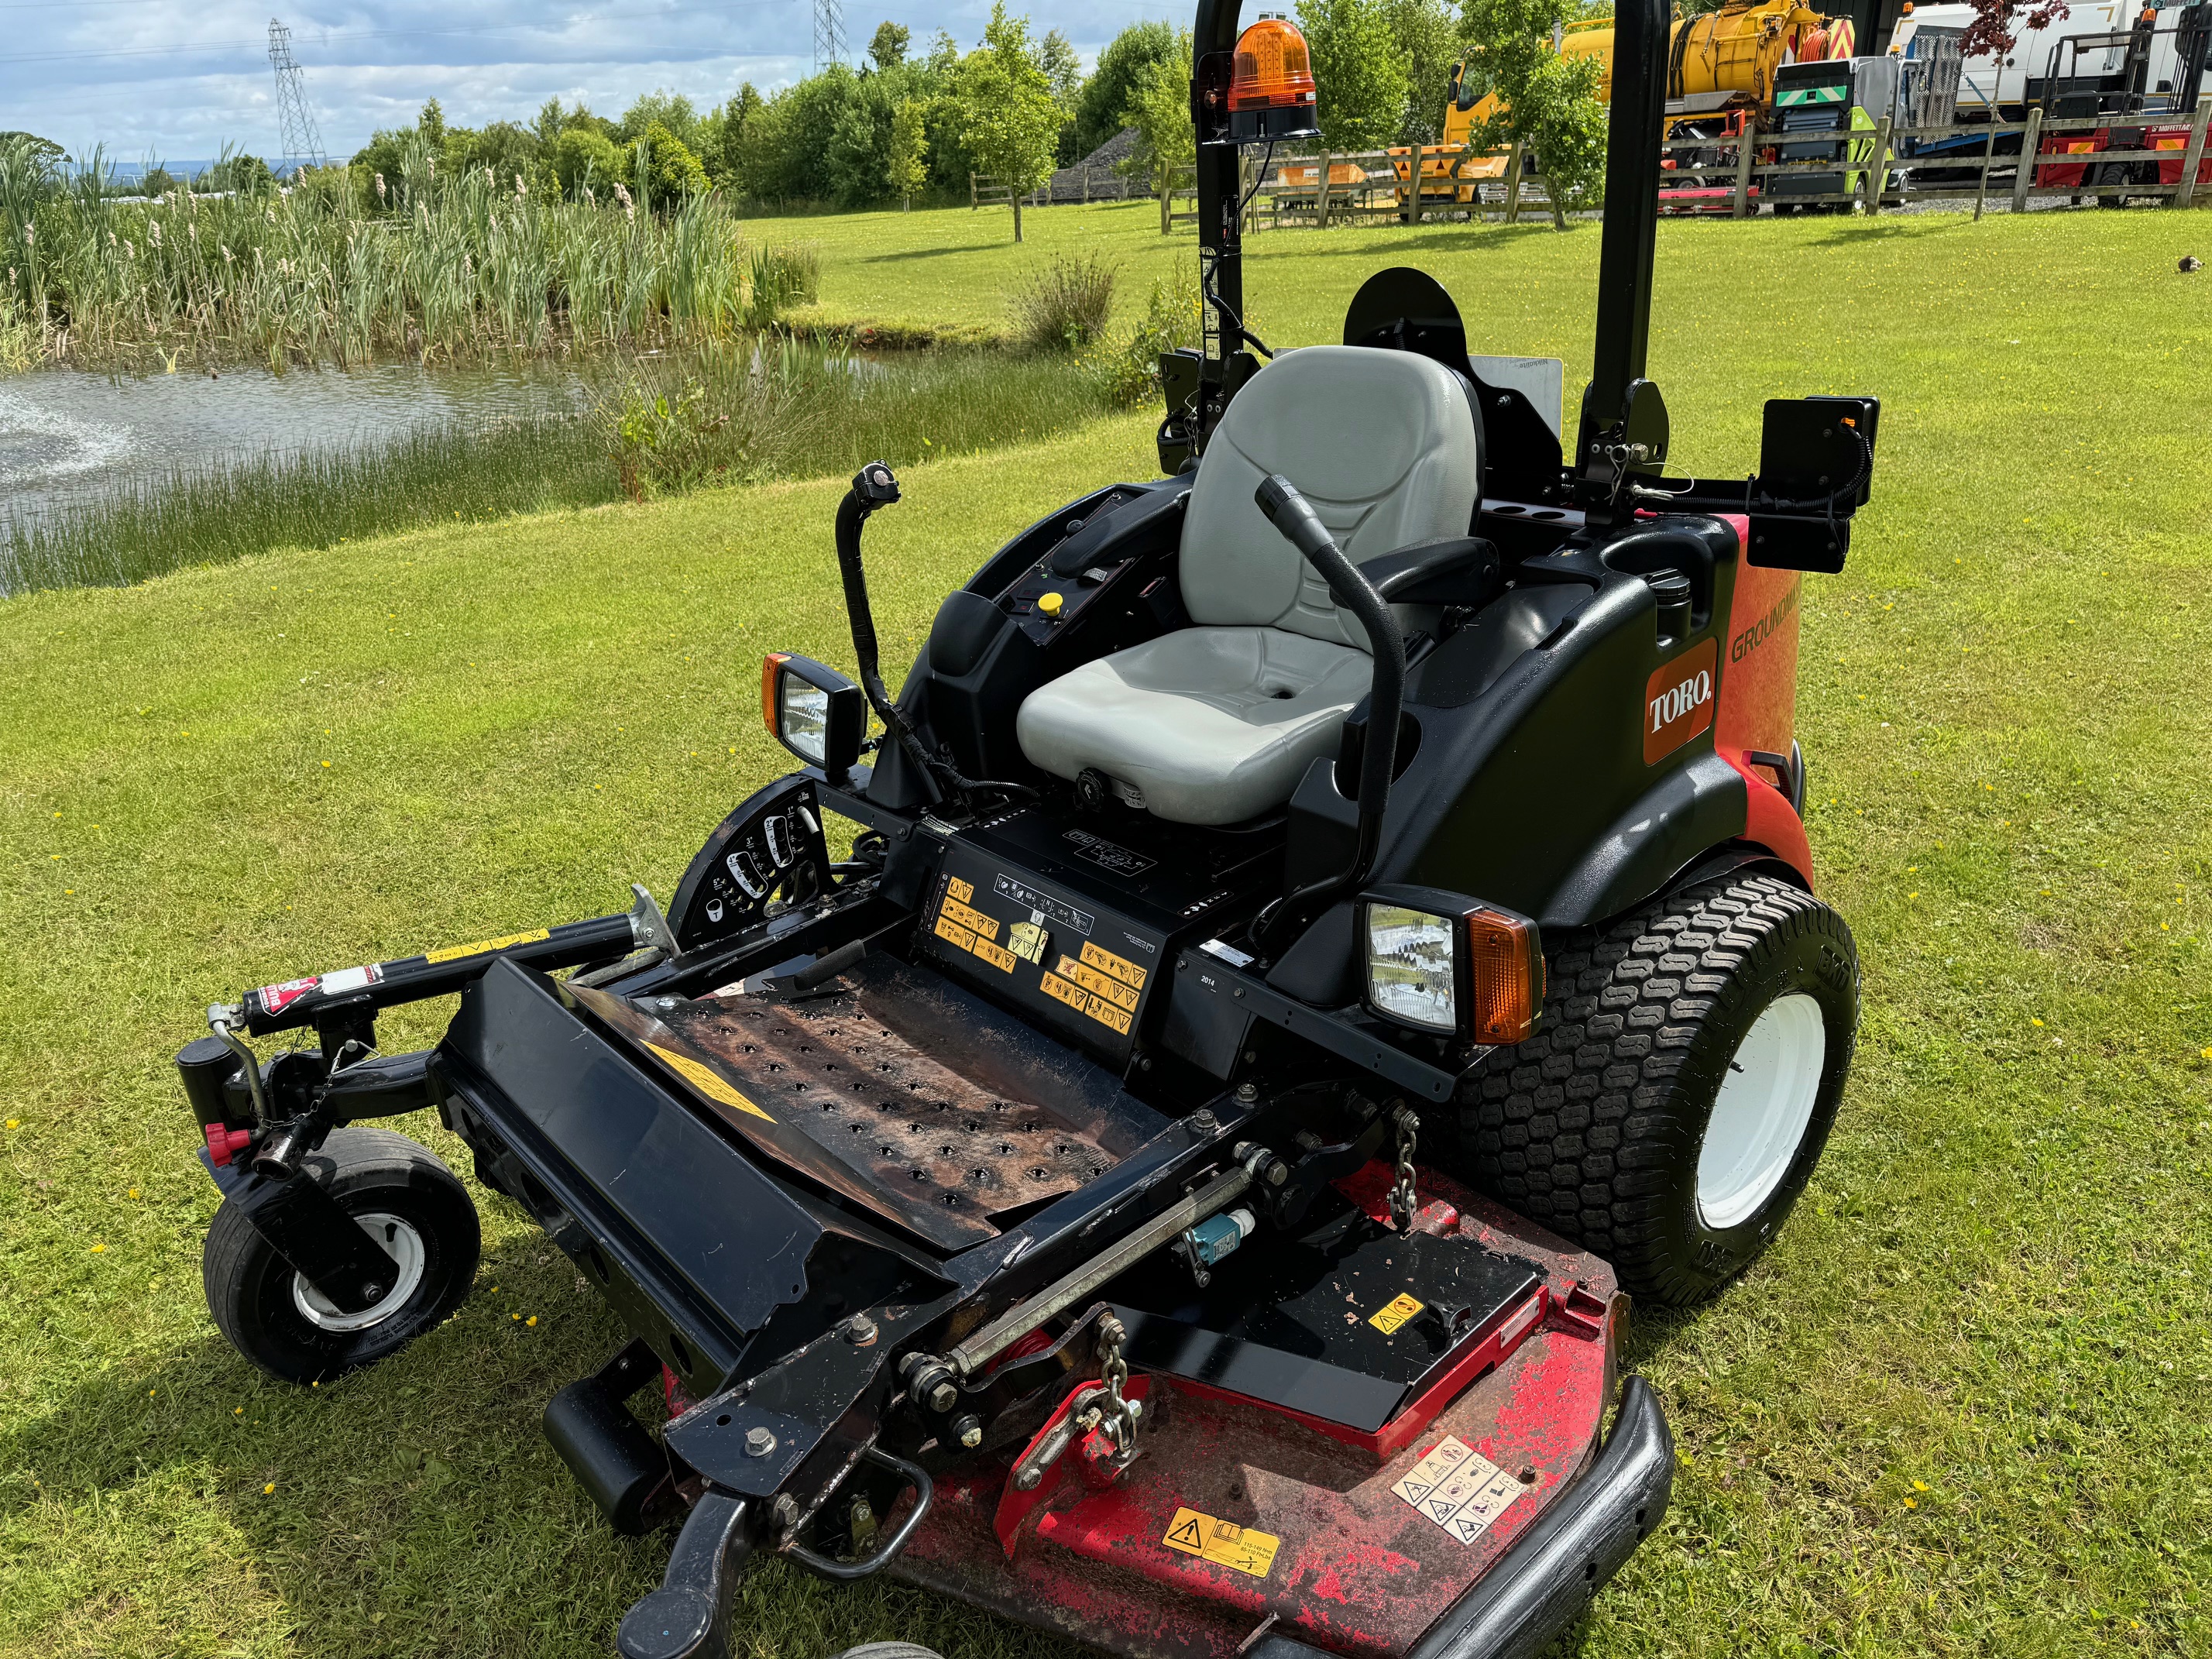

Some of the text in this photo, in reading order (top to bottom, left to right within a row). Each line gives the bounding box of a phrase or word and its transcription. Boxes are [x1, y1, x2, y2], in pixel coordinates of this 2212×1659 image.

[1519, 359, 1548, 369] Nikkalite
[1649, 670, 1709, 733] TORO
[1200, 975, 1215, 987] 2014
[1240, 1546, 1256, 1555] 85-110
[1244, 1541, 1262, 1551] 115-149
